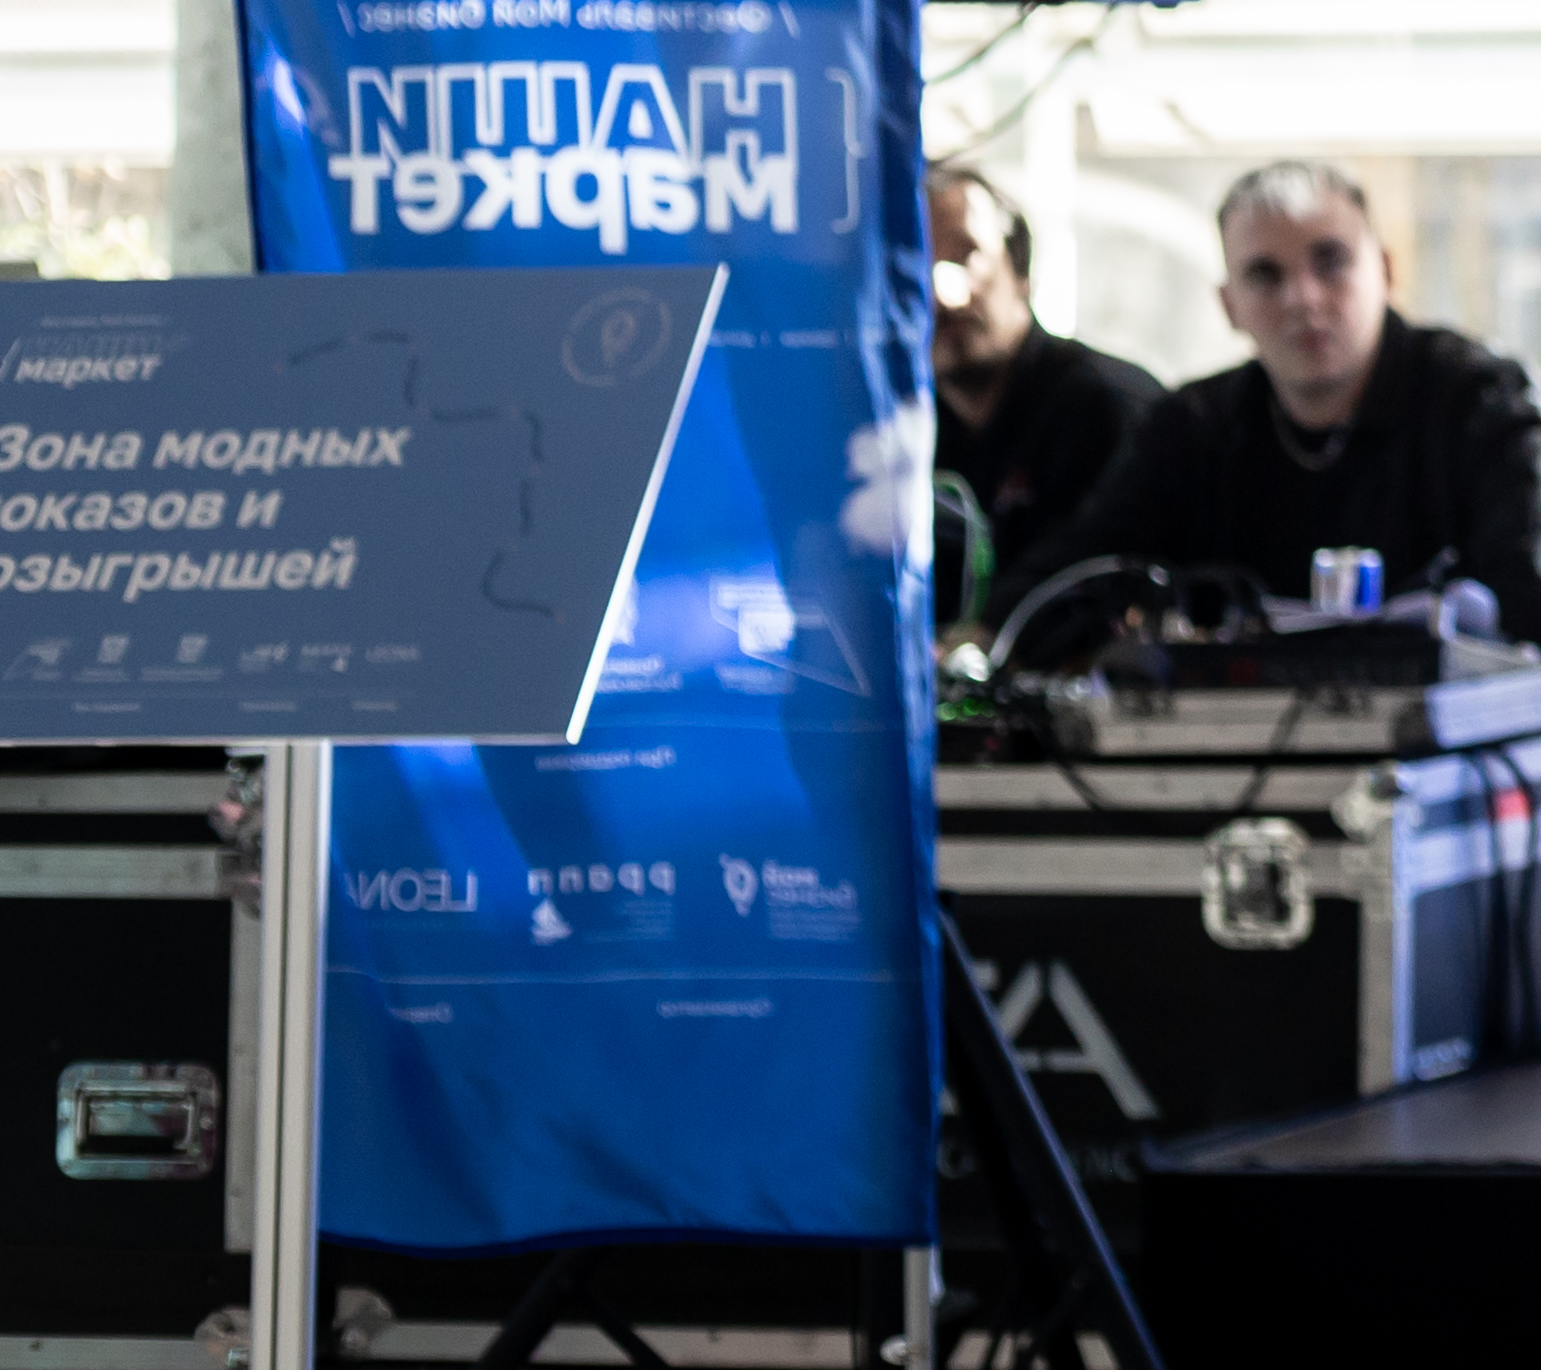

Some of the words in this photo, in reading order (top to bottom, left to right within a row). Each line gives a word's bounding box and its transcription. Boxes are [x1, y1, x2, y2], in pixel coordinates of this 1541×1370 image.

[13, 353, 163, 390] маркет
[0, 423, 142, 472] Зона
[153, 426, 411, 475] модных
[0, 491, 219, 534] оказов
[236, 491, 284, 531] и
